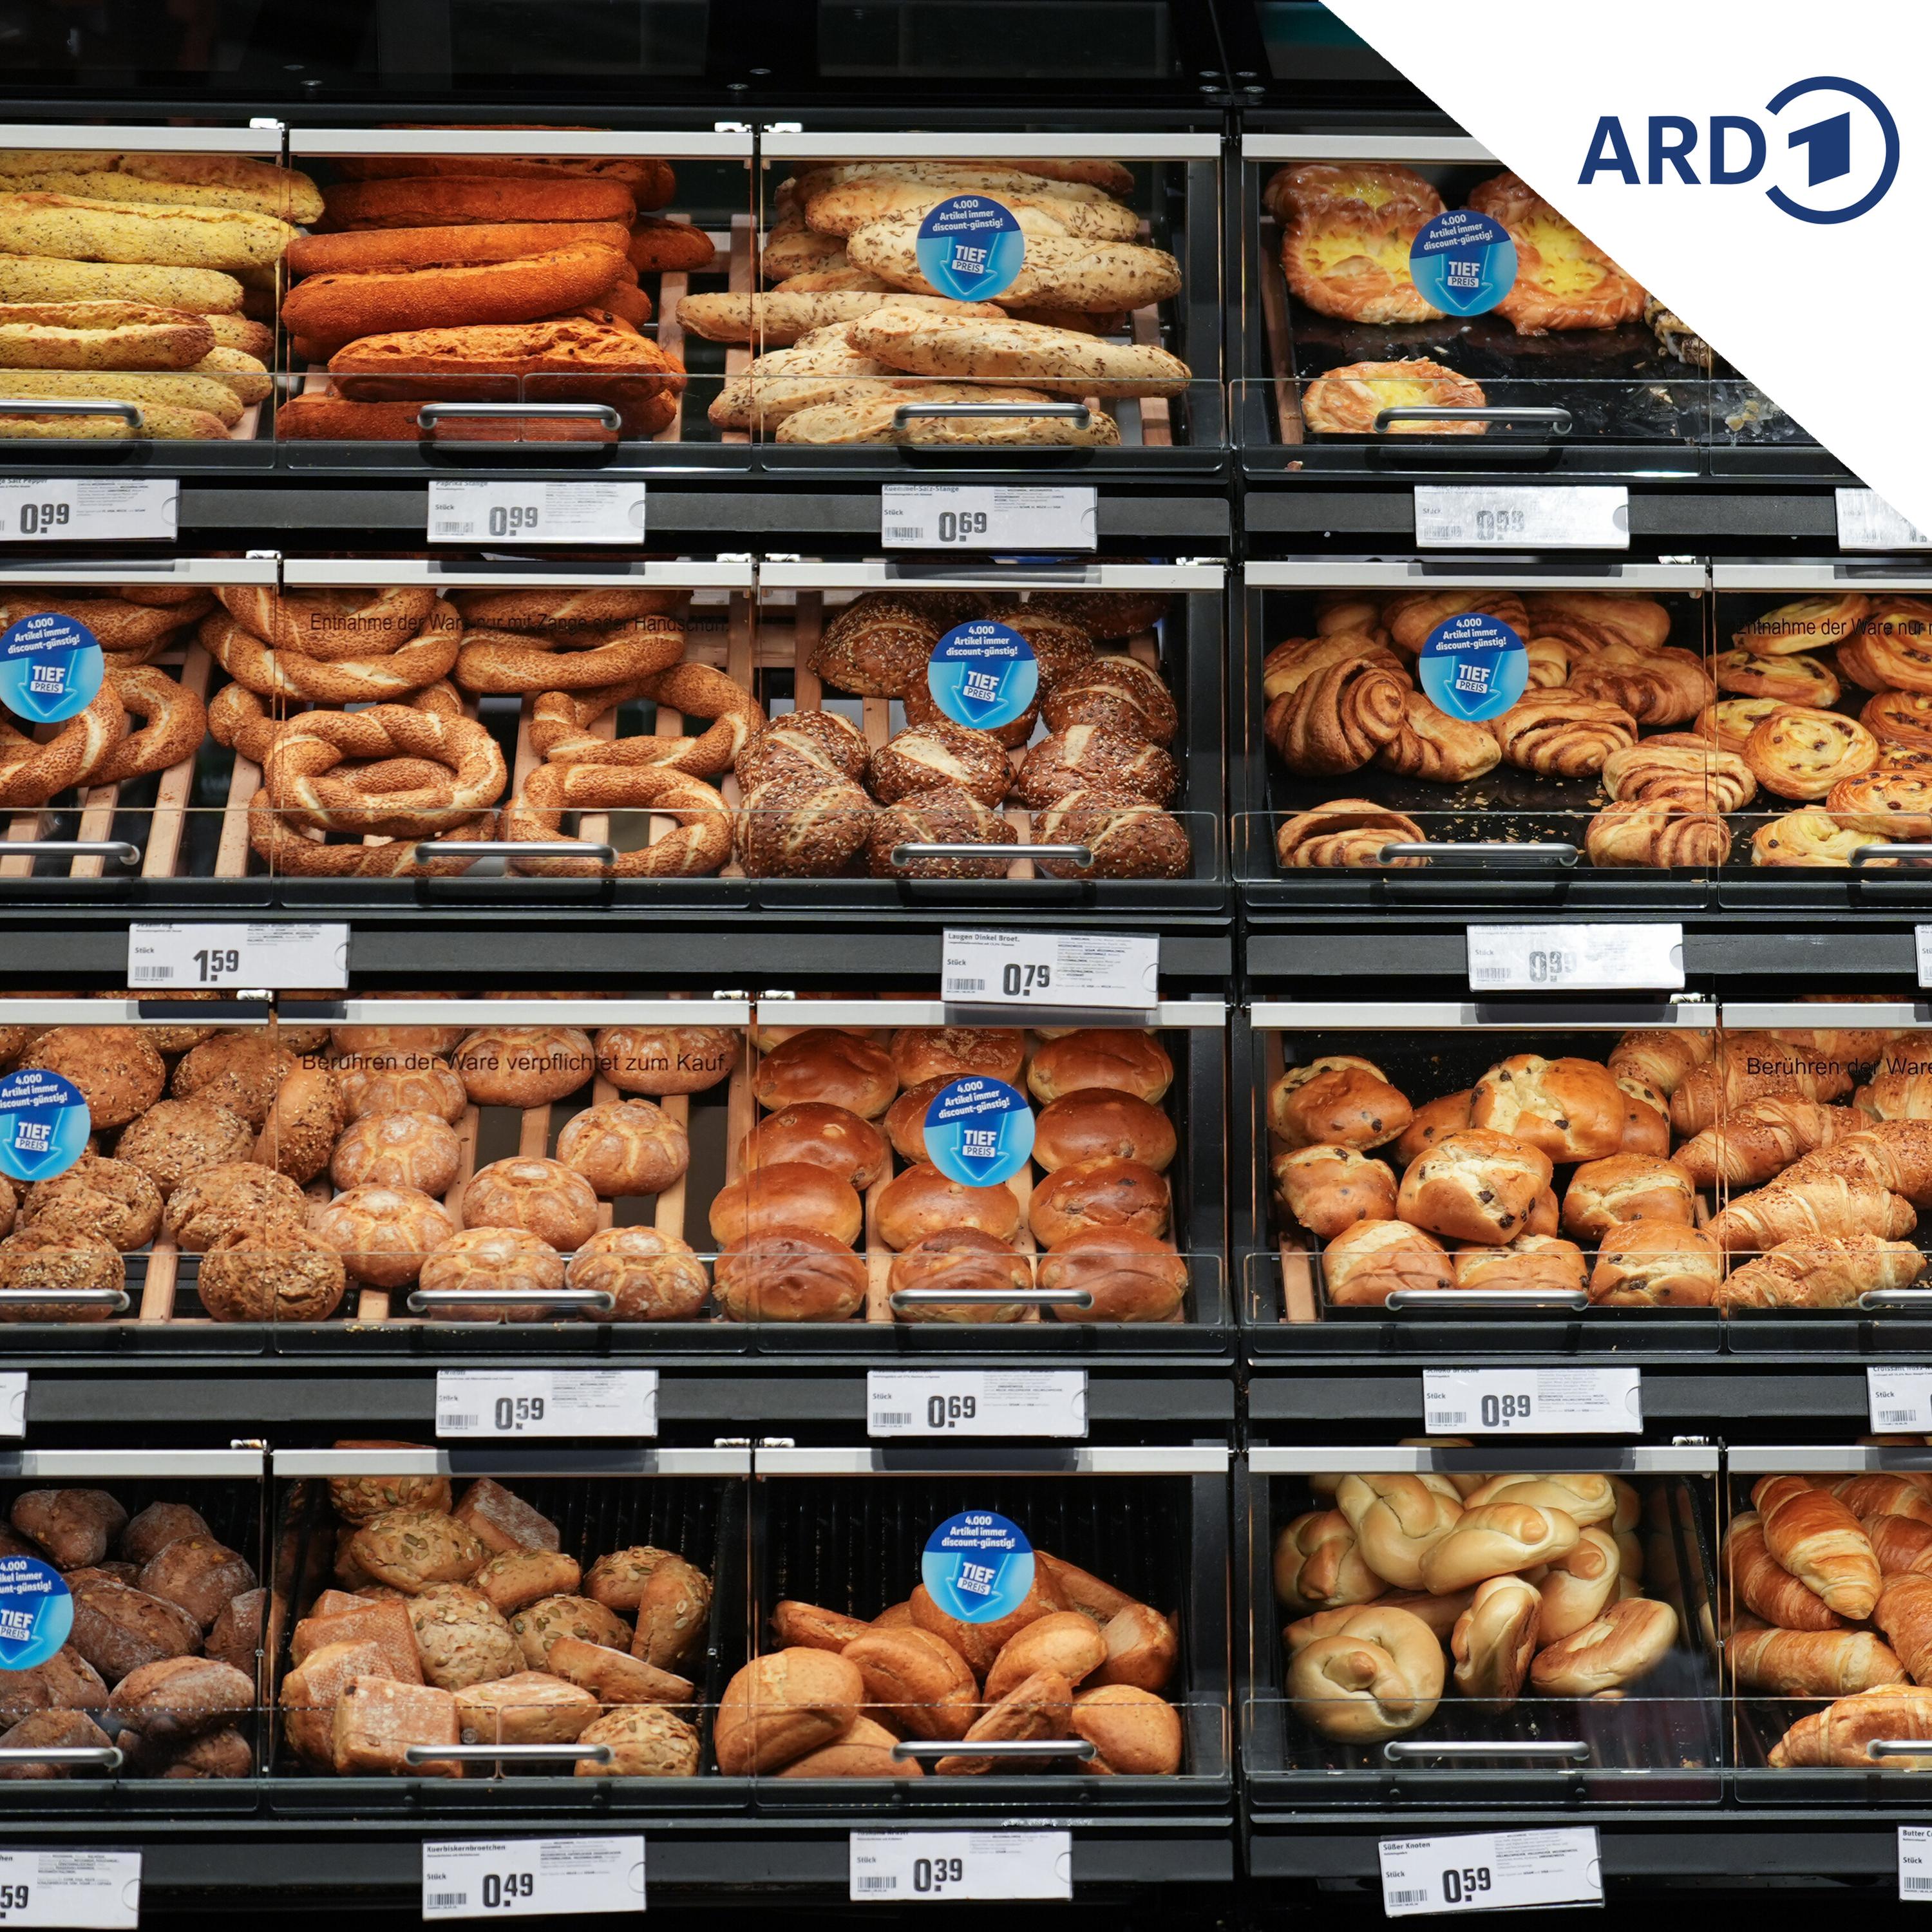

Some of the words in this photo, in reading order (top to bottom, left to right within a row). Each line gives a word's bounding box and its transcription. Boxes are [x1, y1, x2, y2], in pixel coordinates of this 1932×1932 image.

[953, 200, 978, 209] 4.000
[940, 212, 967, 220] Artikel
[969, 210, 994, 218] immer
[1441, 214, 1466, 225] 4.000
[933, 218, 1003, 232] discount-günstig!
[1430, 227, 1457, 239] Artikel
[1458, 223, 1482, 233] immer
[1424, 230, 1493, 250] discount-günstig!
[955, 245, 987, 262] TIEF
[956, 261, 980, 272] PREIS
[1448, 261, 1481, 276] TIEF
[1452, 277, 1475, 286] PREIS
[20, 504, 70, 534] 0.99
[489, 507, 538, 536] 0.99
[938, 512, 987, 542] 0.69
[28, 617, 54, 629] 4.000
[310, 613, 392, 630] Entnahme
[397, 613, 424, 630] der
[429, 613, 471, 630] Ware
[1456, 618, 1482, 627] 4.000
[1821, 618, 1846, 634] der
[1852, 618, 1892, 634] Ware
[1898, 622, 1926, 635] nur
[14, 629, 43, 643] Artikel
[44, 627, 70, 638] immer
[969, 626, 994, 634] 4.000
[1443, 630, 1470, 639] Artikel
[1472, 629, 1497, 638] immer
[8, 634, 80, 654] discount-günstig!
[954, 637, 982, 645] Artikel
[1435, 636, 1506, 650] discount-günstig!
[946, 647, 1018, 657] discount-günstig!
[32, 665, 66, 682] TIEF
[967, 670, 999, 690] TIEF
[1459, 664, 1490, 682] TIEF
[35, 682, 59, 692] PREIS
[967, 688, 992, 700] PREIS
[1460, 681, 1484, 692] PREIS
[193, 950, 239, 981] 1.59
[1003, 963, 1050, 996] 0.79
[302, 1053, 397, 1070] Berühren
[404, 1053, 438, 1070] der
[448, 1053, 499, 1070] Ware
[506, 1054, 618, 1074] verpflichtet
[625, 1057, 668, 1071] zum
[677, 1054, 728, 1071] Kauf.
[1747, 1057, 1839, 1075] Berühren
[1847, 1057, 1879, 1075] der
[15, 1074, 43, 1084] 4.000
[1, 1086, 30, 1097] Artikel
[31, 1084, 59, 1095] immer
[957, 1081, 983, 1094] 4.000
[0, 1092, 68, 1108] iscount-günstig!
[945, 1095, 973, 1107] Artikel
[974, 1090, 1000, 1101] immer
[938, 1097, 1010, 1119] discount-günstig!
[18, 1122, 52, 1140] TIEF
[963, 1130, 996, 1146] TIEF
[19, 1139, 44, 1150] PREIS
[967, 1147, 991, 1156] PREIS
[495, 1397, 544, 1430] 0.59
[927, 1396, 976, 1428] 0.69
[1481, 1394, 1531, 1427] 0.89
[965, 1515, 992, 1525] 4.000
[950, 1526, 979, 1536] Artikel
[980, 1527, 1007, 1536] immer
[942, 1537, 1016, 1549] discount-günstig!
[0, 1560, 27, 1571] 4.000
[963, 1562, 996, 1584] TIEF
[15, 1572, 43, 1582] immer
[961, 1580, 986, 1593] PREIS
[1, 1609, 33, 1629] TIEF
[1, 1627, 26, 1639] PREIS
[426, 1844, 506, 1853] Kuerbiskernbroetchen
[913, 1859, 963, 1892] 0.39
[482, 1873, 533, 1908] 0.49
[1443, 1867, 1491, 1903] 0.59
